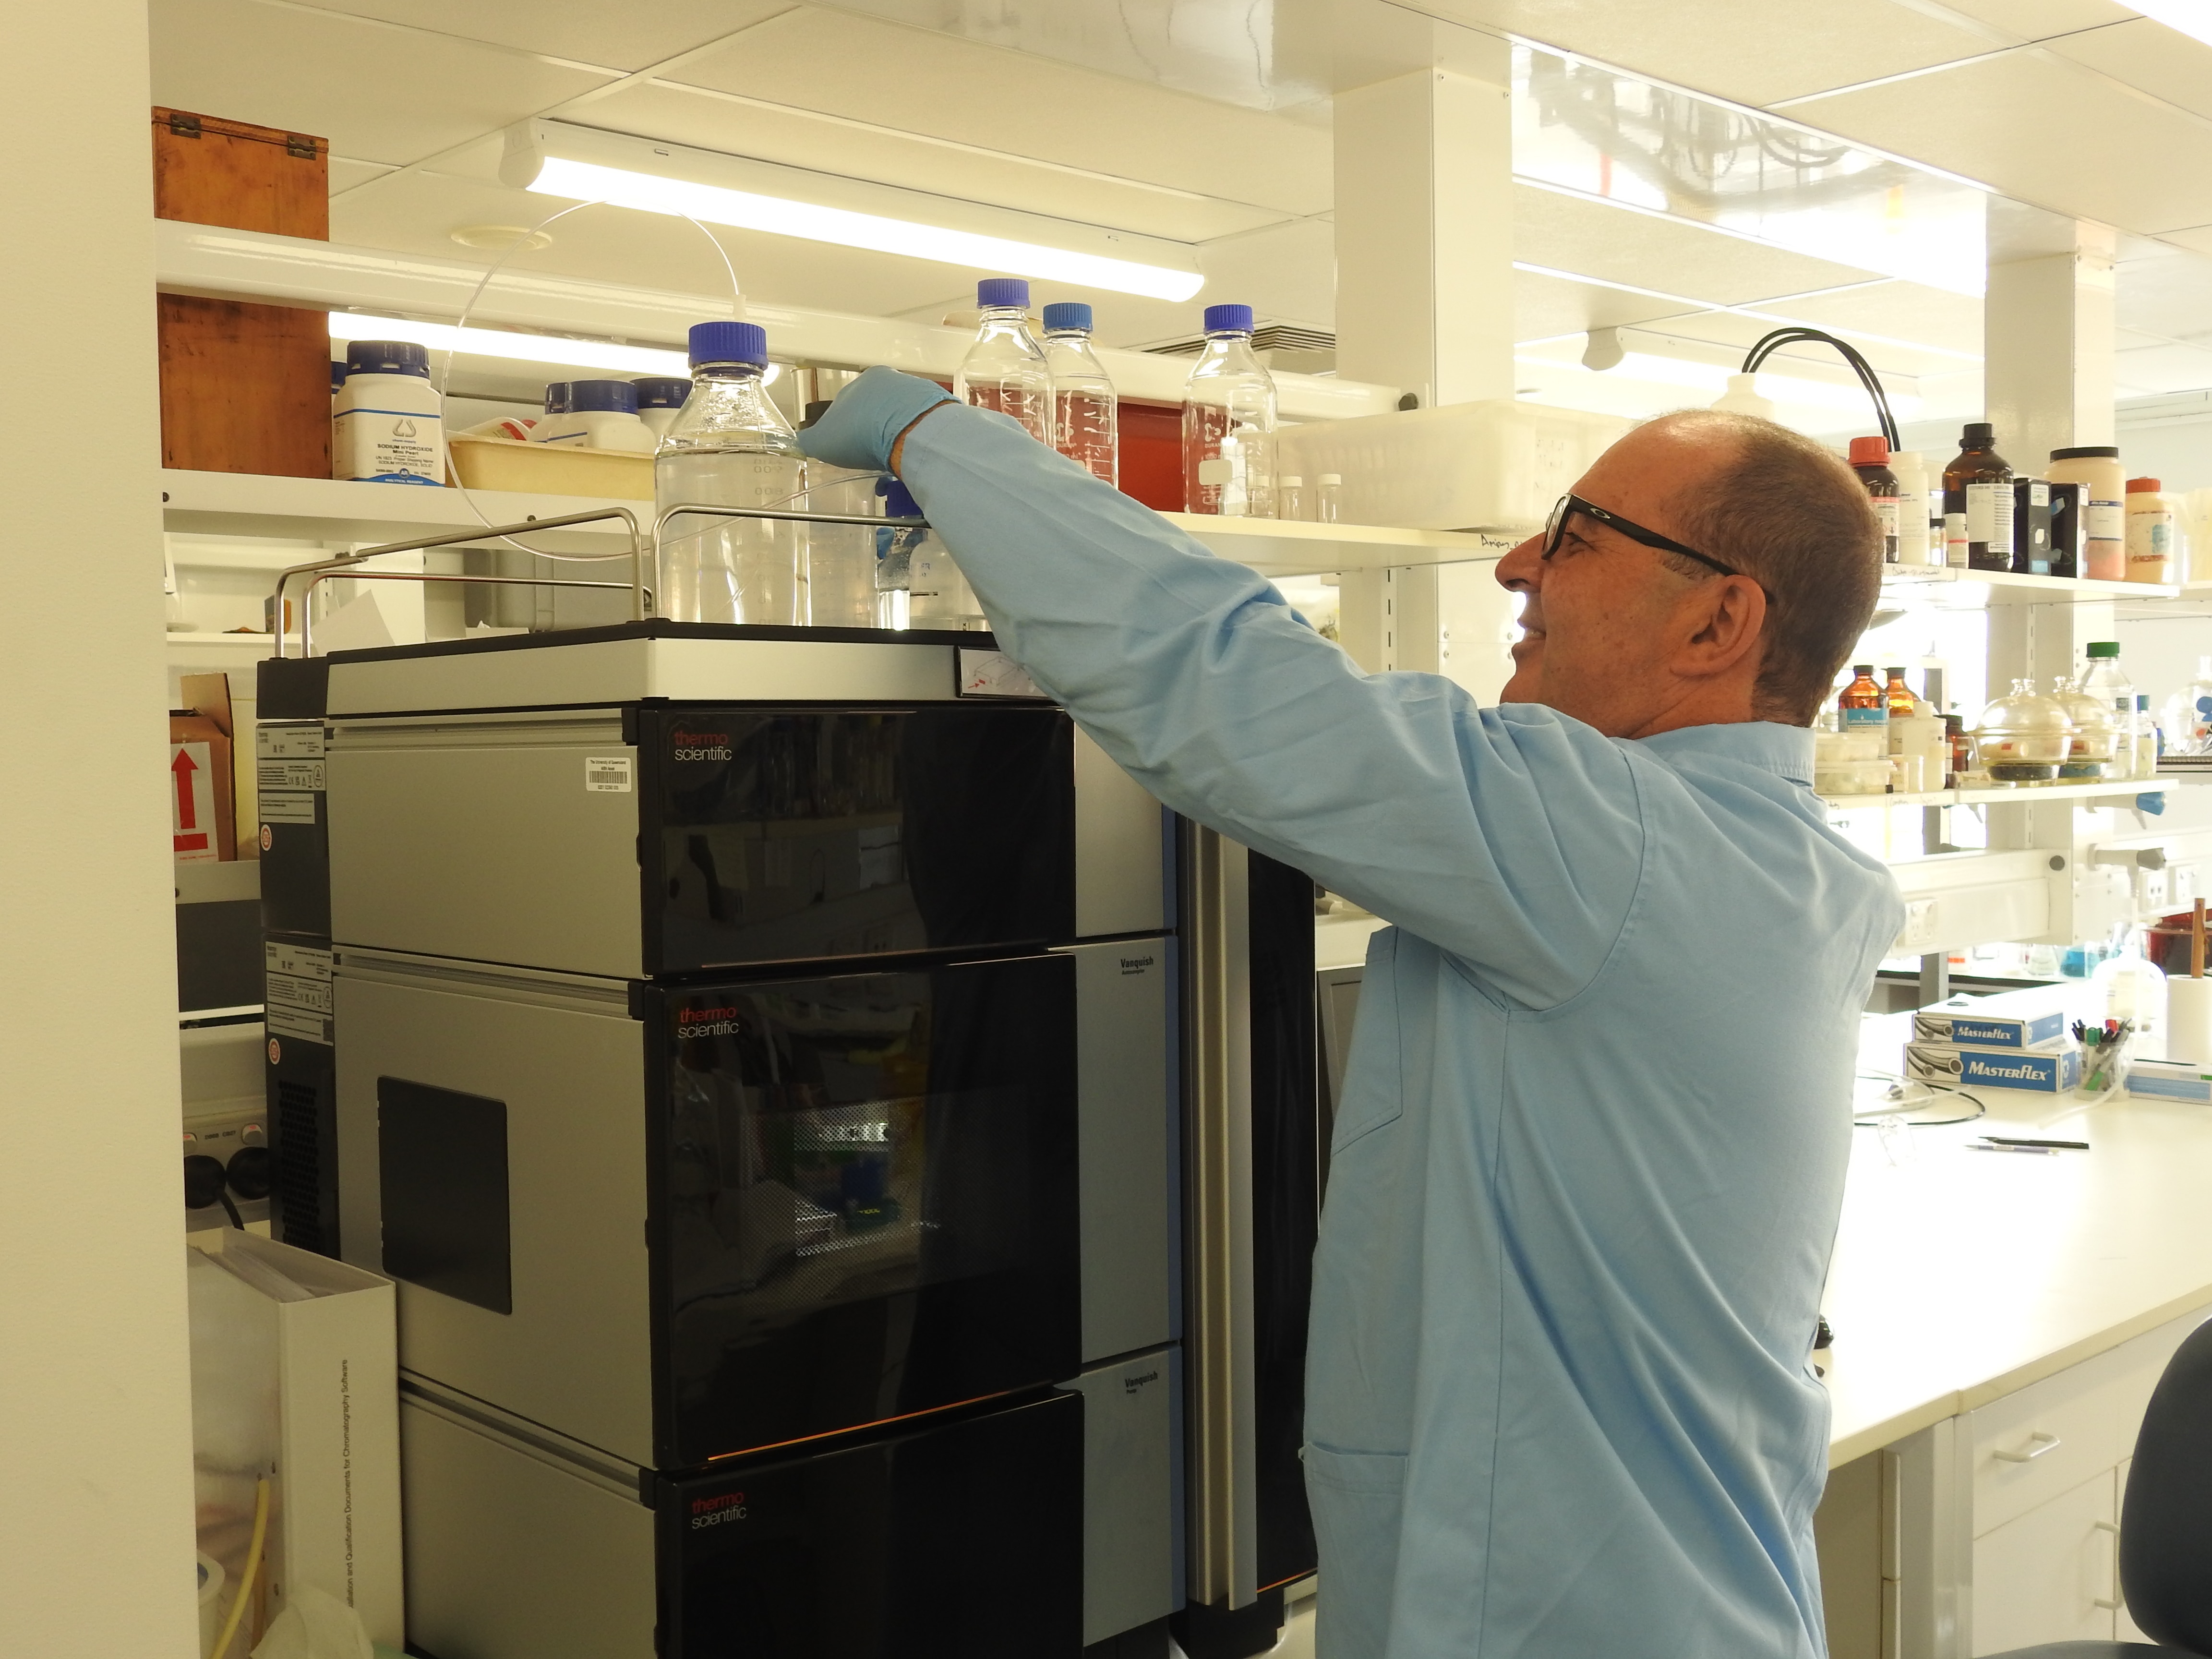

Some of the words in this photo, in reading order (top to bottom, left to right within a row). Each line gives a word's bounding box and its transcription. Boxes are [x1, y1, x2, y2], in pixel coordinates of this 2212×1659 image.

[674, 730, 729, 745] thermo
[675, 745, 732, 761] scientific
[1120, 956, 1154, 969] Vanquish
[680, 1007, 737, 1023] thermo
[678, 1021, 739, 1038] scientific
[1125, 1371, 1158, 1388] Vanquish
[692, 1492, 745, 1514] thermo
[692, 1505, 747, 1529] scientific
